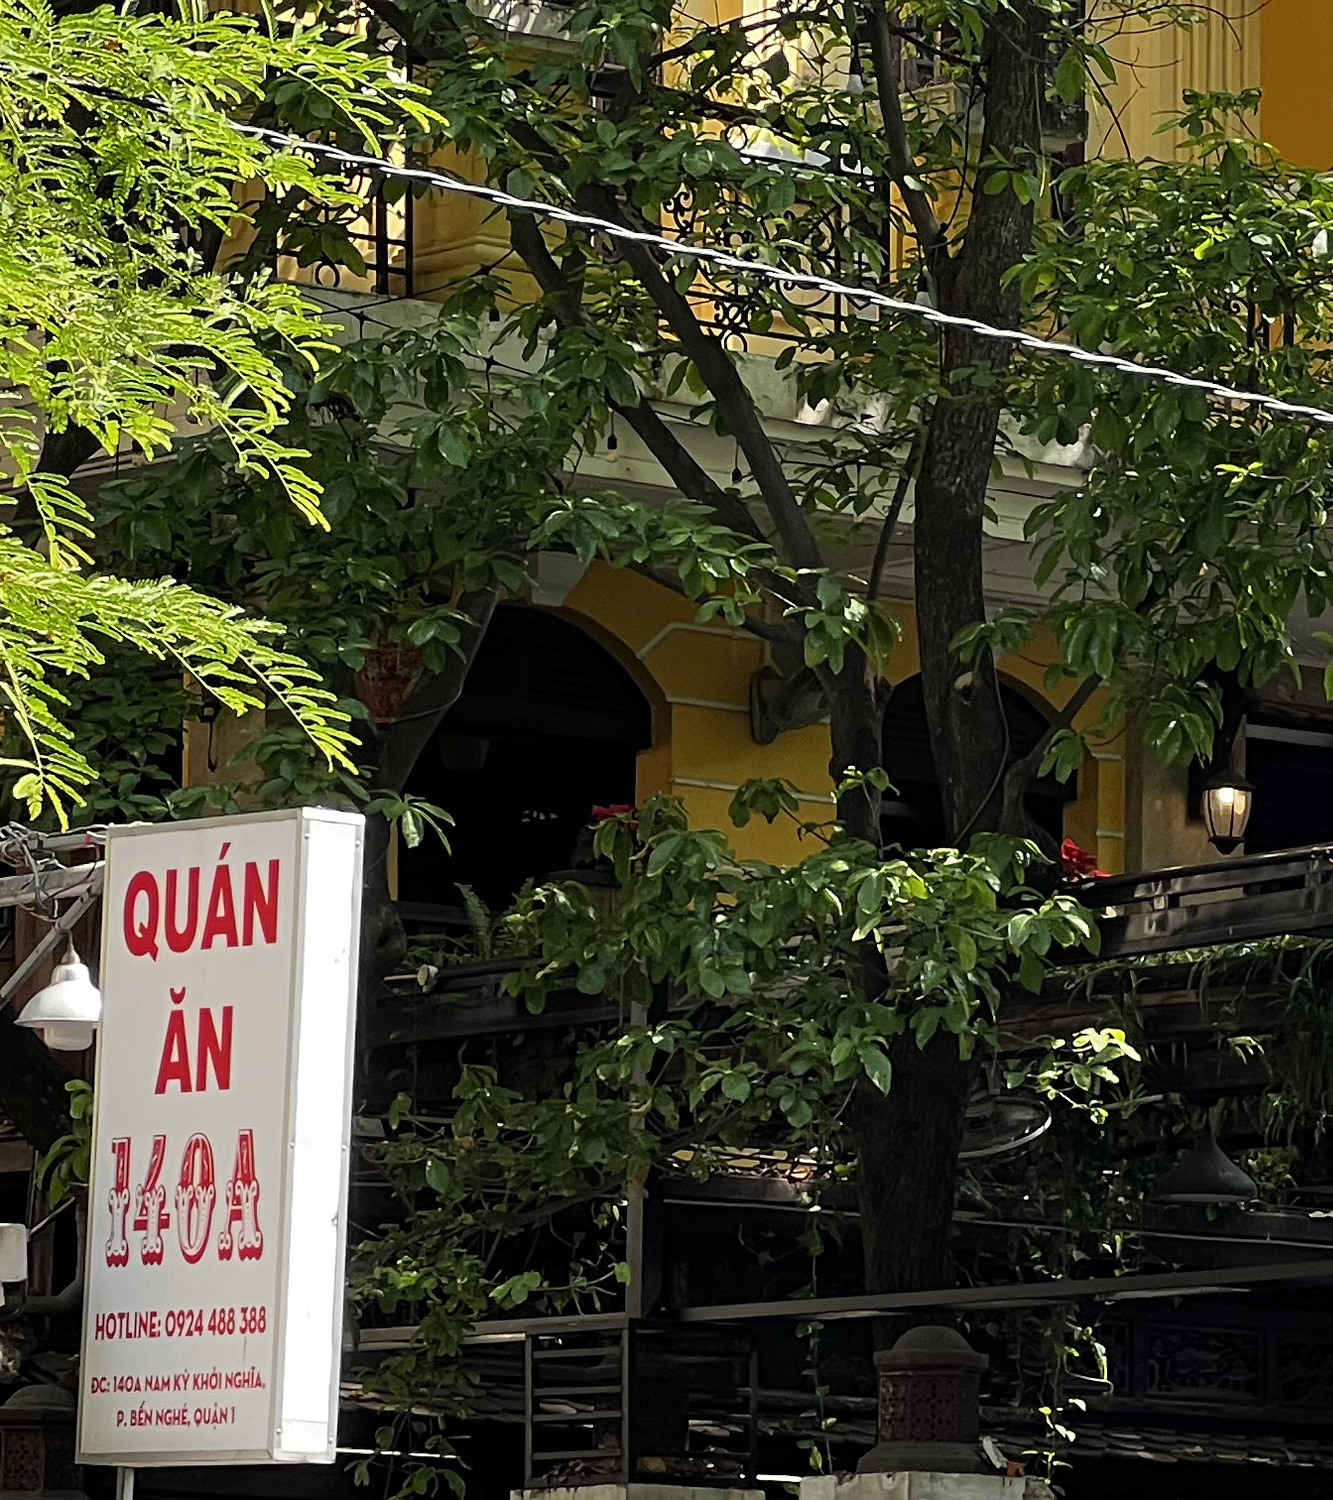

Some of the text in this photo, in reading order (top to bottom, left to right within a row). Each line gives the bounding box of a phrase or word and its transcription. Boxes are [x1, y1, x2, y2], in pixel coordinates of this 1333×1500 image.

[123, 842, 280, 962] QUÁN
[154, 987, 234, 1094] ĂN
[106, 1129, 263, 1267] 140A
[95, 1306, 266, 1340] HOTLINE: 0924 488 388
[91, 1376, 110, 1394] ĐC:
[113, 1375, 141, 1393] 140A
[145, 1375, 170, 1392] NAM
[193, 1366, 222, 1390] KHỞI
[117, 1410, 127, 1427] P.
[130, 1401, 152, 1426] BẾN
[194, 1402, 228, 1430] QUẬN
